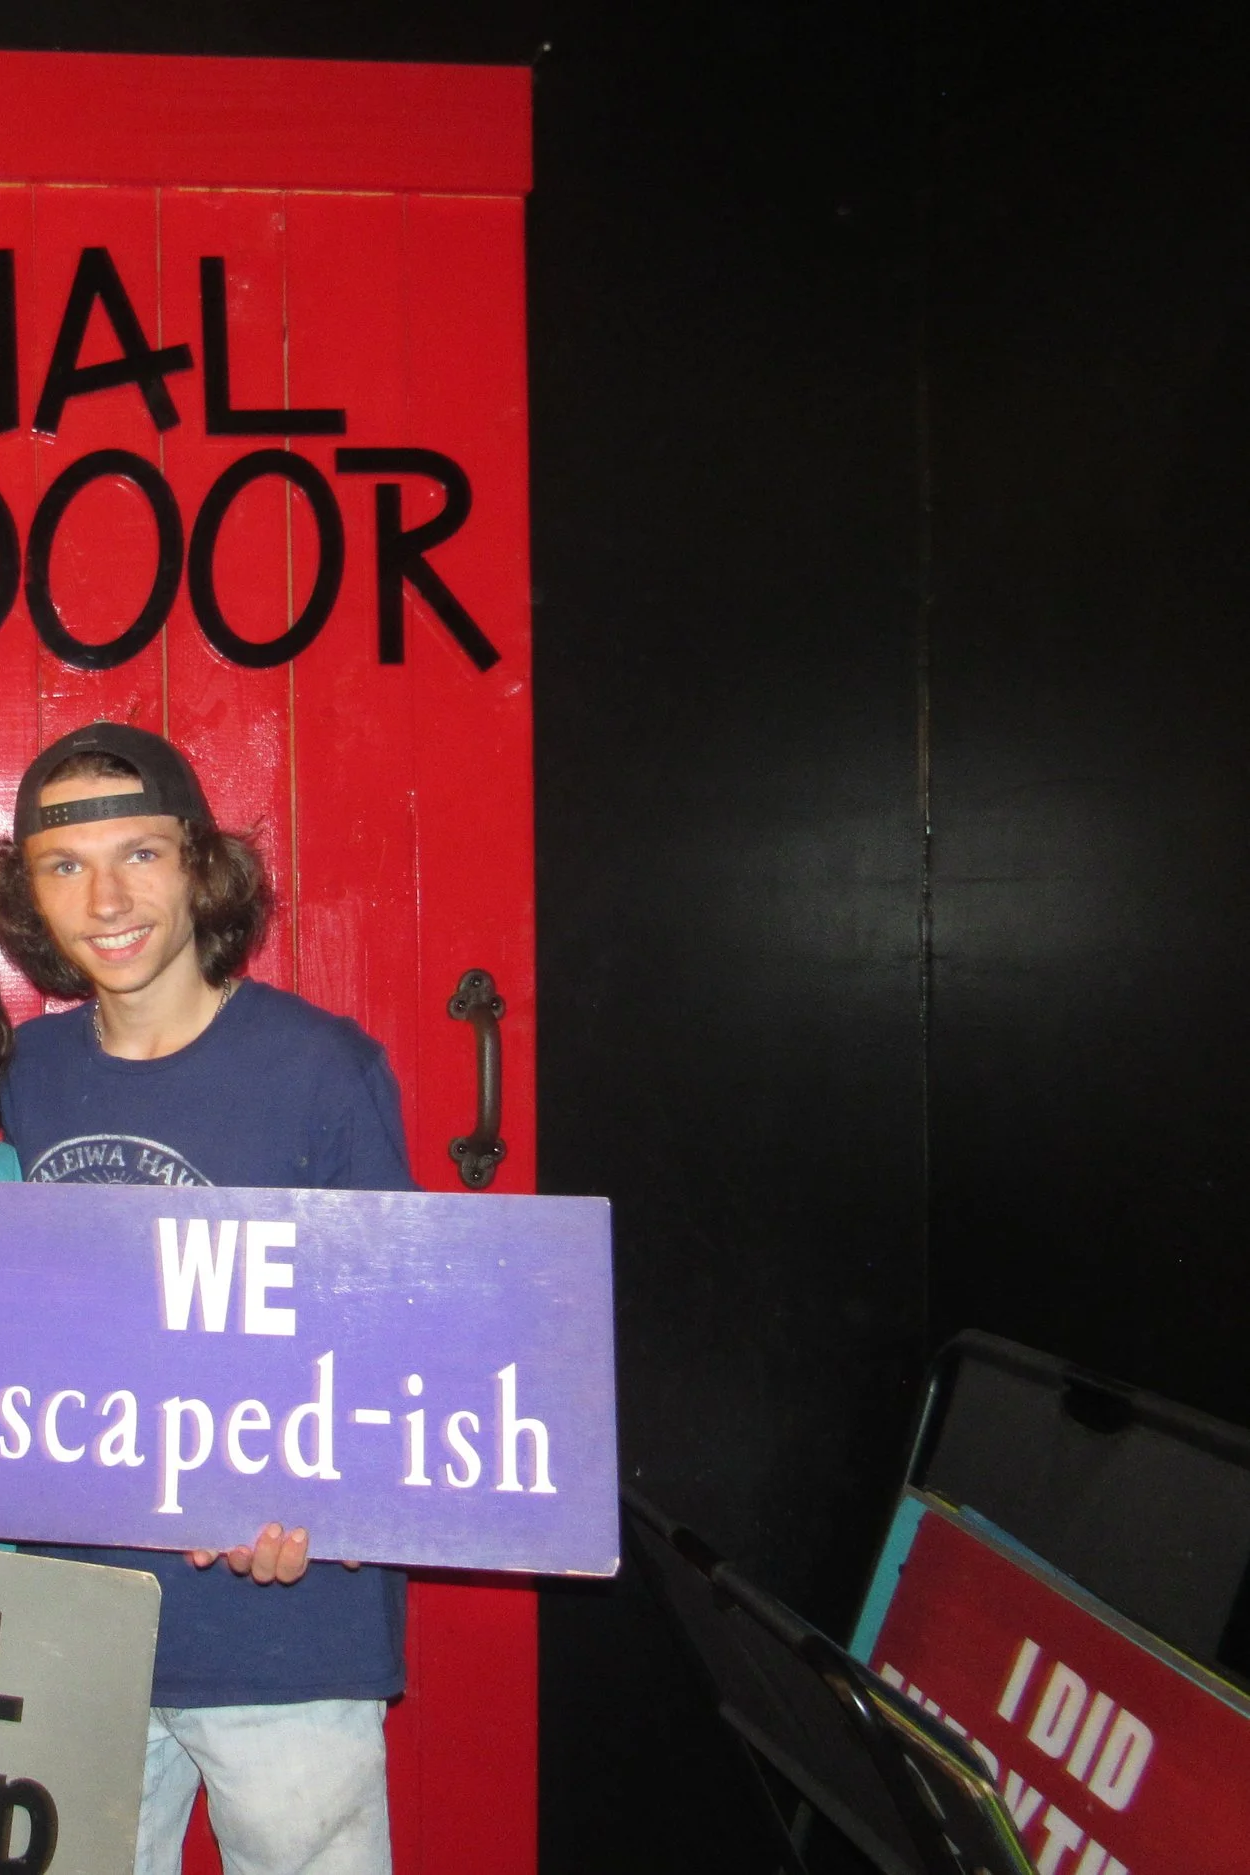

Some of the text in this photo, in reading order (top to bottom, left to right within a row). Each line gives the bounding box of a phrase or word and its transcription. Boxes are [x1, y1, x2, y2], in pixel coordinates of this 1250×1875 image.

[31, 1143, 126, 1184] ALEIWA
[157, 1216, 297, 1337] WE
[996, 1636, 1042, 1724] I
[1026, 1660, 1155, 1813] DID
